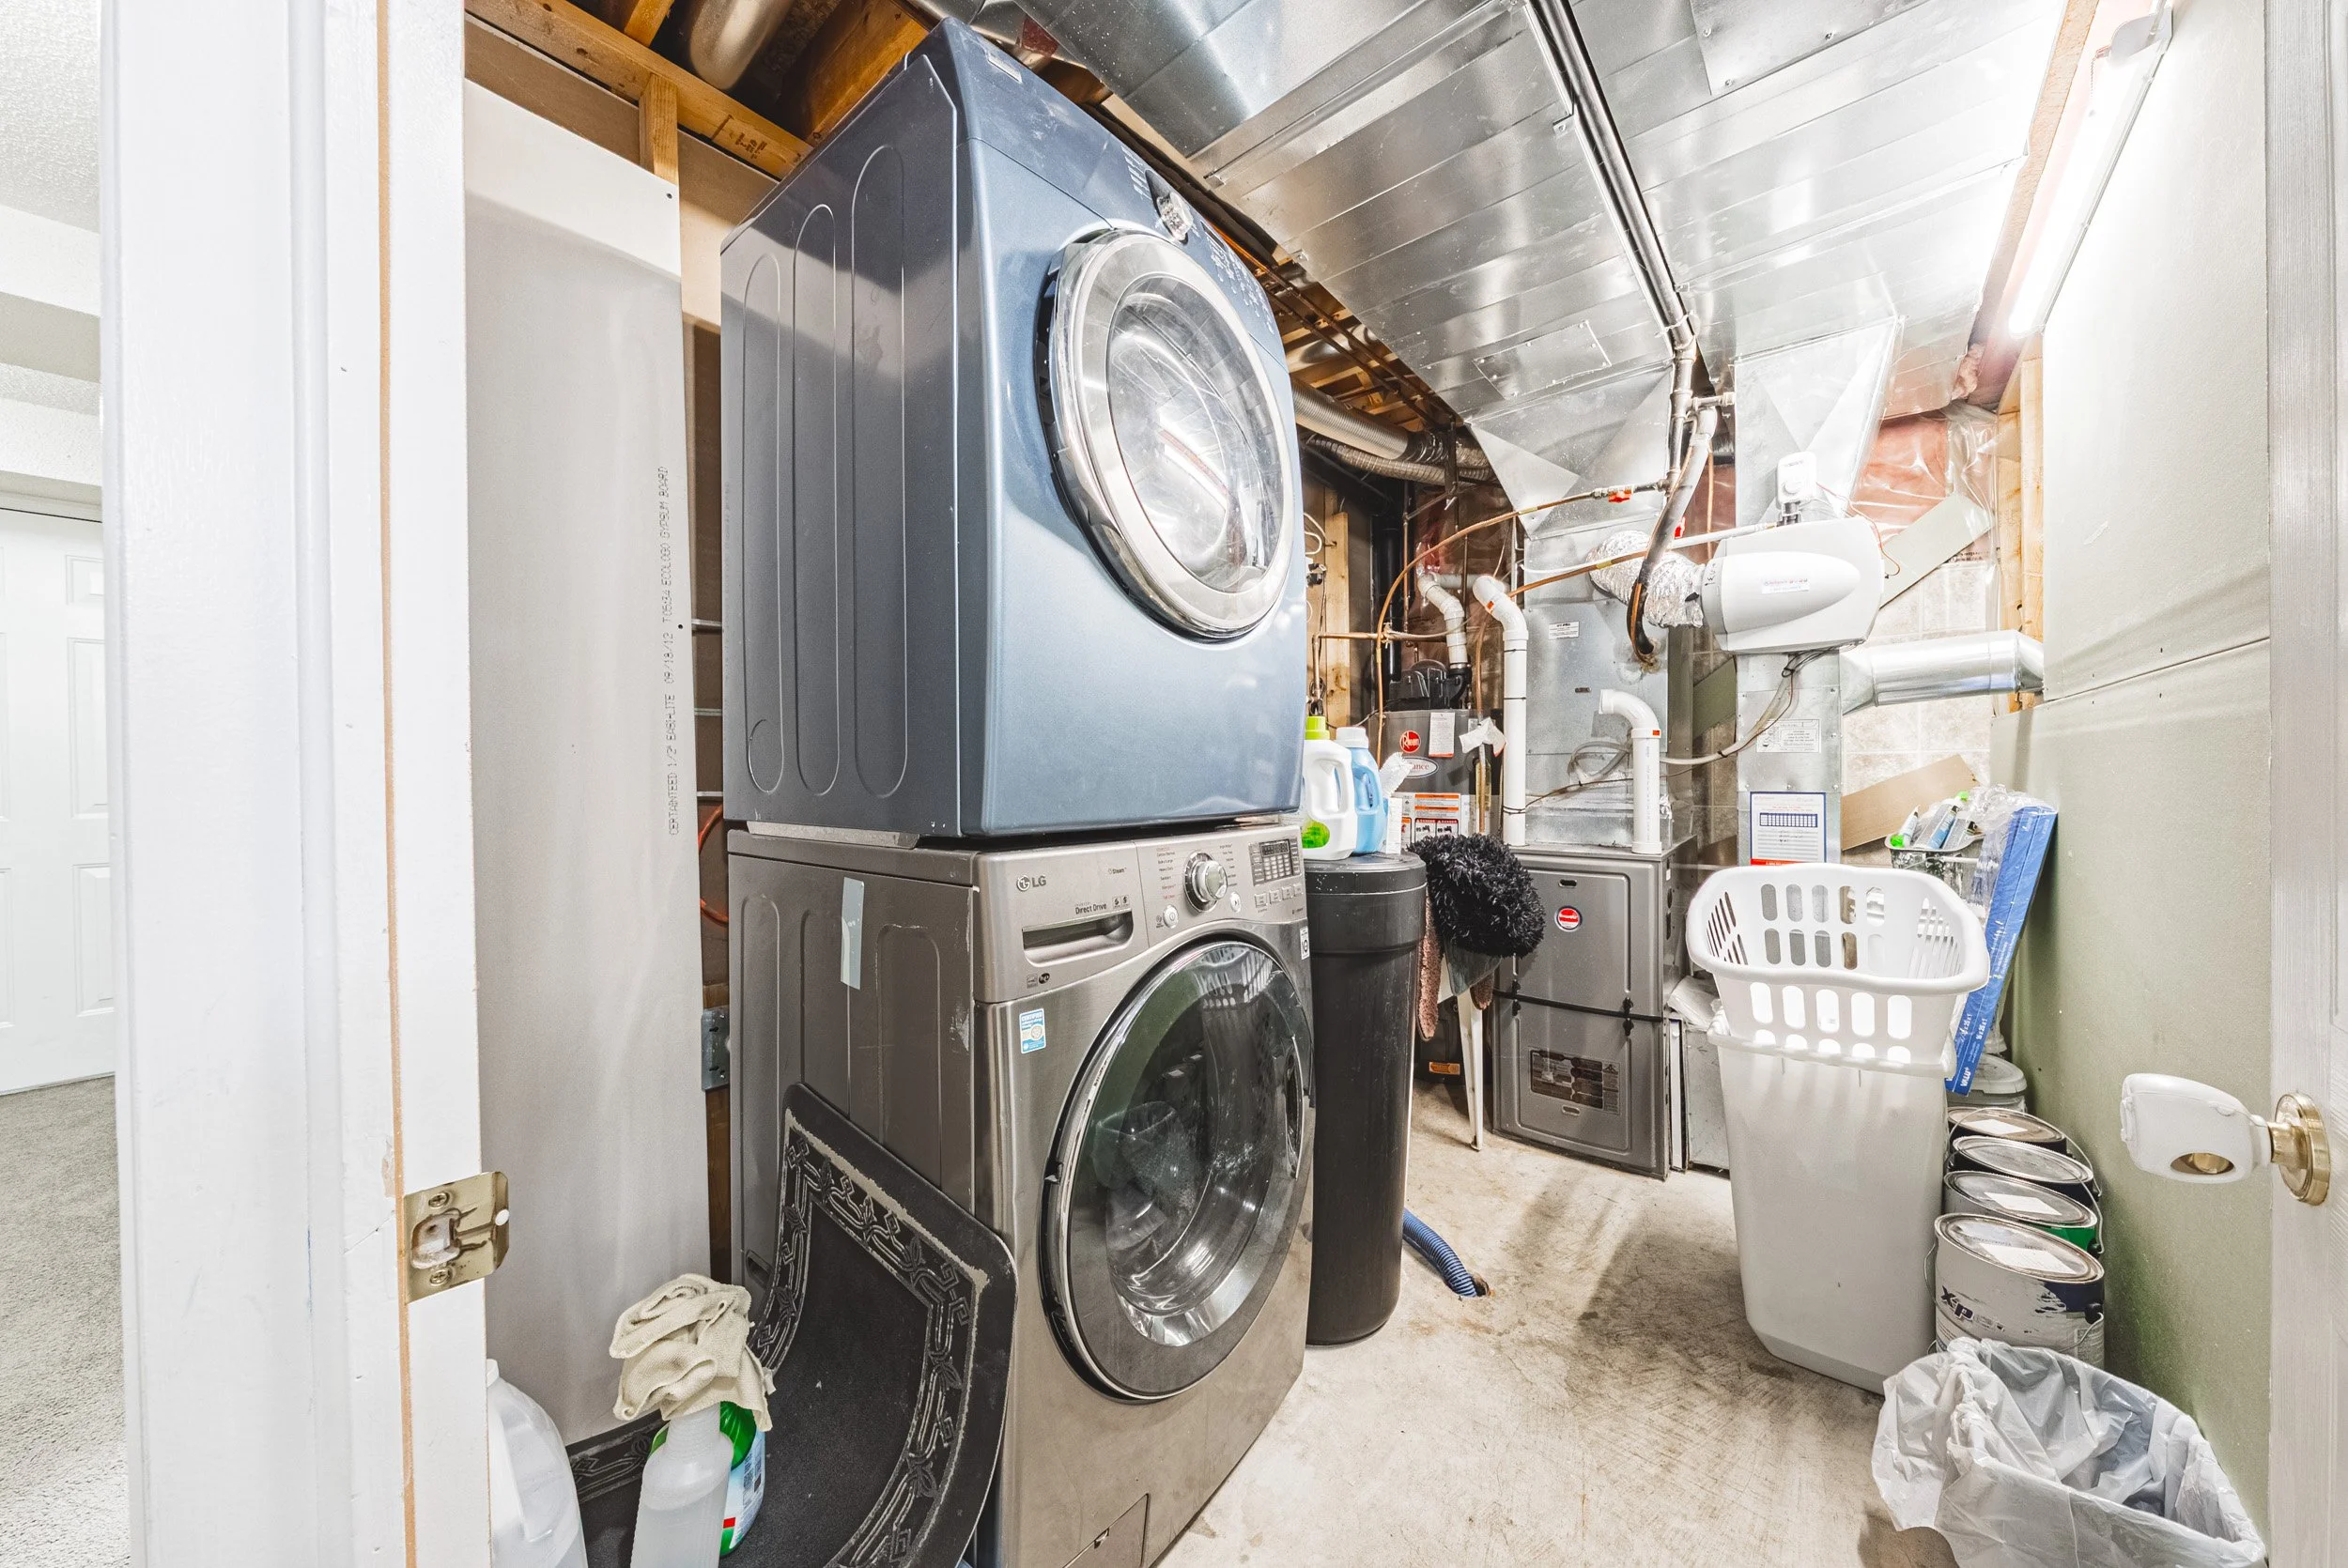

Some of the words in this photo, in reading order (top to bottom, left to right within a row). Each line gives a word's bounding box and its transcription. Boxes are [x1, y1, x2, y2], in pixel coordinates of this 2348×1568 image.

[657, 466, 670, 498] BOARD
[658, 500, 671, 539] GYPSUM
[1074, 905, 1092, 915] Direct
[1092, 903, 1107, 912] Drive
